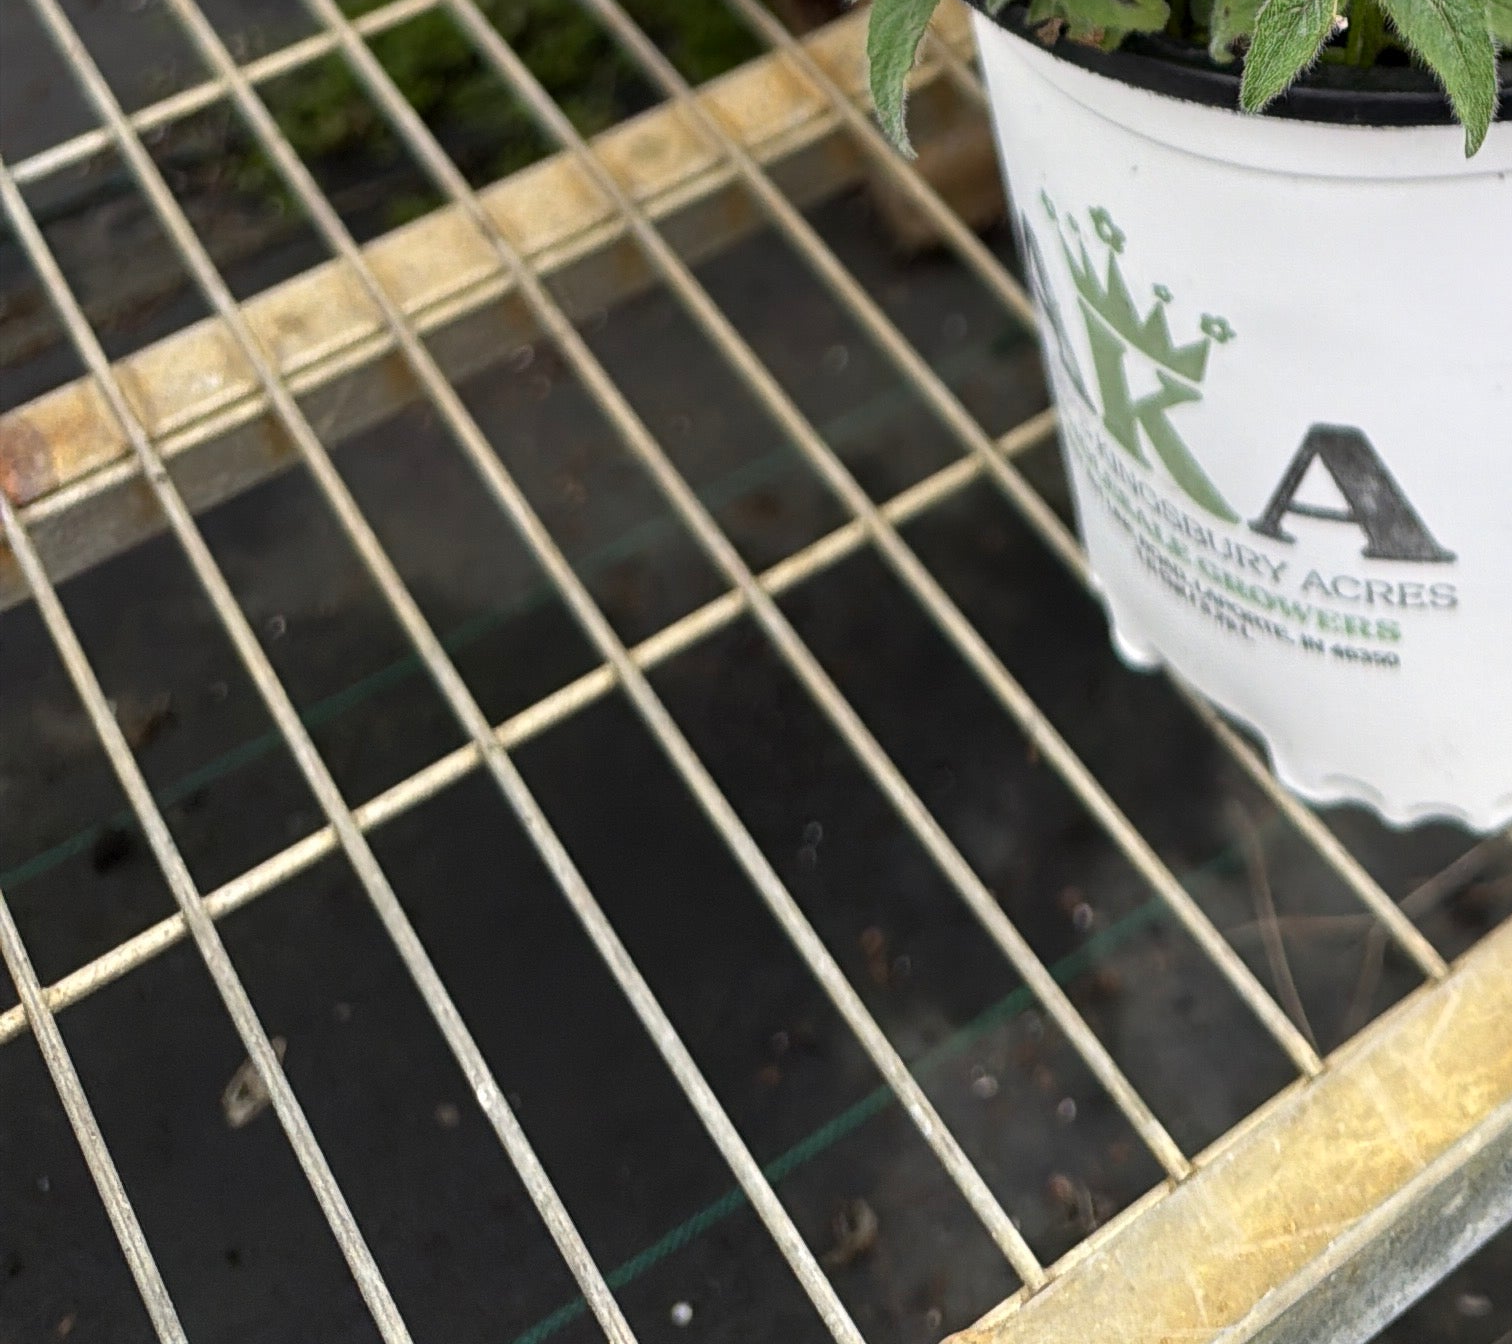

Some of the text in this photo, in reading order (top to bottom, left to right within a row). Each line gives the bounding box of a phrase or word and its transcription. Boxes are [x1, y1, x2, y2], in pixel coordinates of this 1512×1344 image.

[1197, 557, 1401, 643] GROWERS
[1301, 568, 1459, 609] ACRES
[1301, 631, 1326, 655] IN
